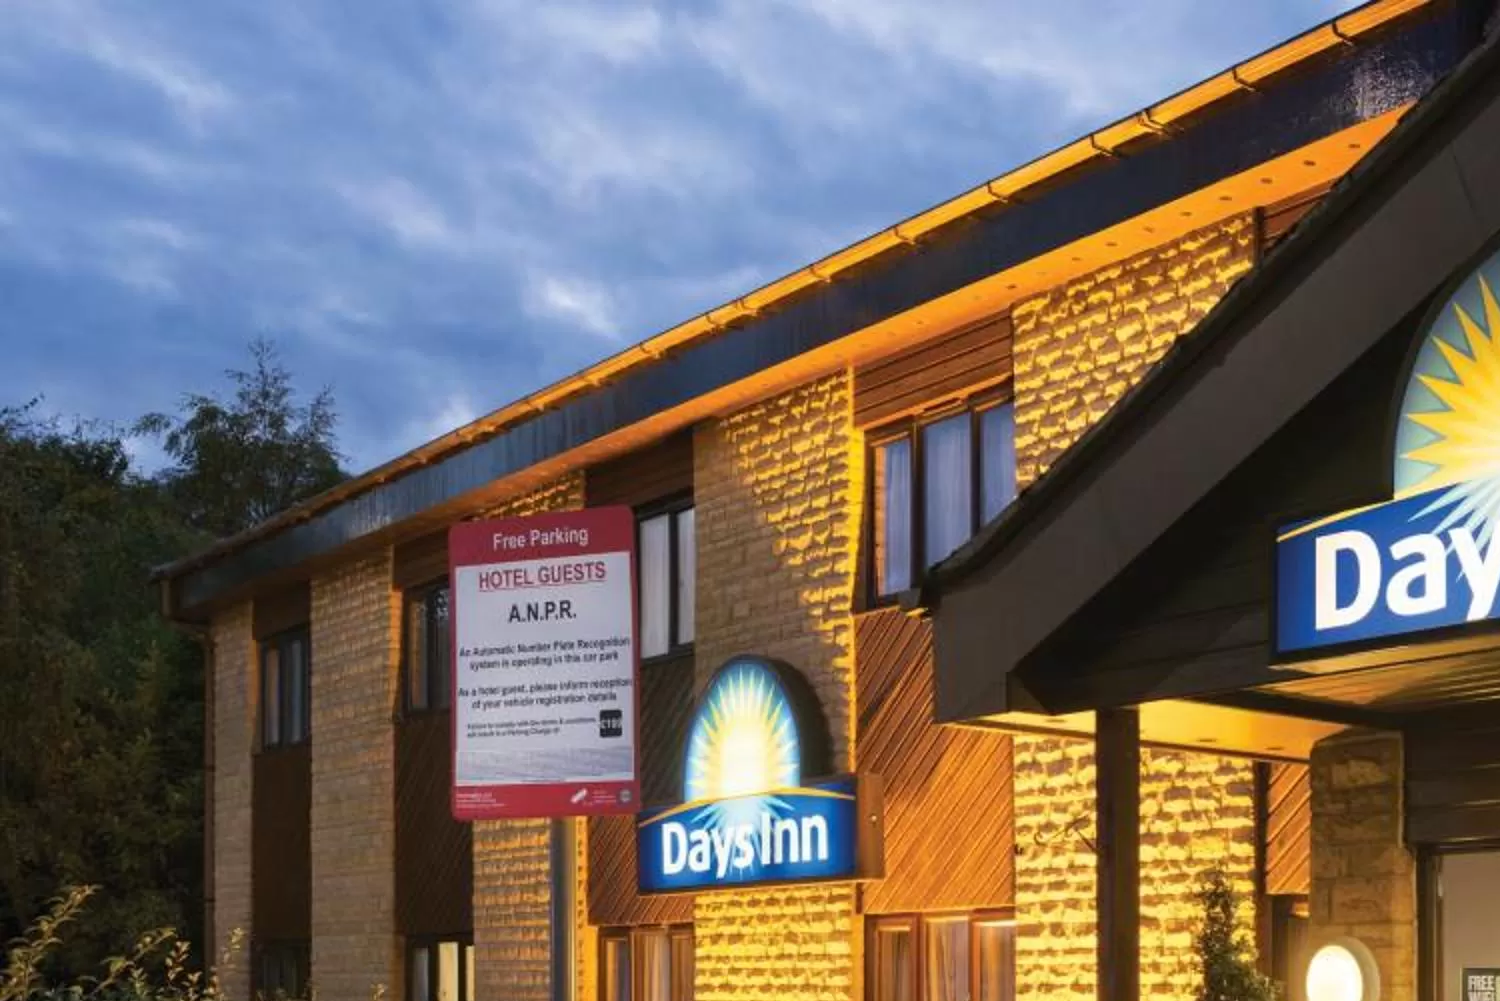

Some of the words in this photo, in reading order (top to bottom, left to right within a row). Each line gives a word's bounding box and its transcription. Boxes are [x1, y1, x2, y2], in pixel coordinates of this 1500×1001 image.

[493, 532, 526, 551] Free
[531, 527, 589, 546] Parking
[479, 567, 533, 590] HOTEL
[538, 561, 606, 584] GUESTS
[508, 600, 577, 623] A.N.P.R.
[517, 642, 551, 653] Number
[577, 637, 630, 651] Recognition
[470, 659, 500, 672] system
[511, 655, 552, 668] operating
[599, 650, 619, 663] park
[529, 681, 558, 693] please
[559, 680, 588, 691] inform
[535, 693, 586, 707] registration
[662, 822, 754, 878] Days
[761, 813, 829, 865] Inn
[1468, 975, 1495, 990] FREE
